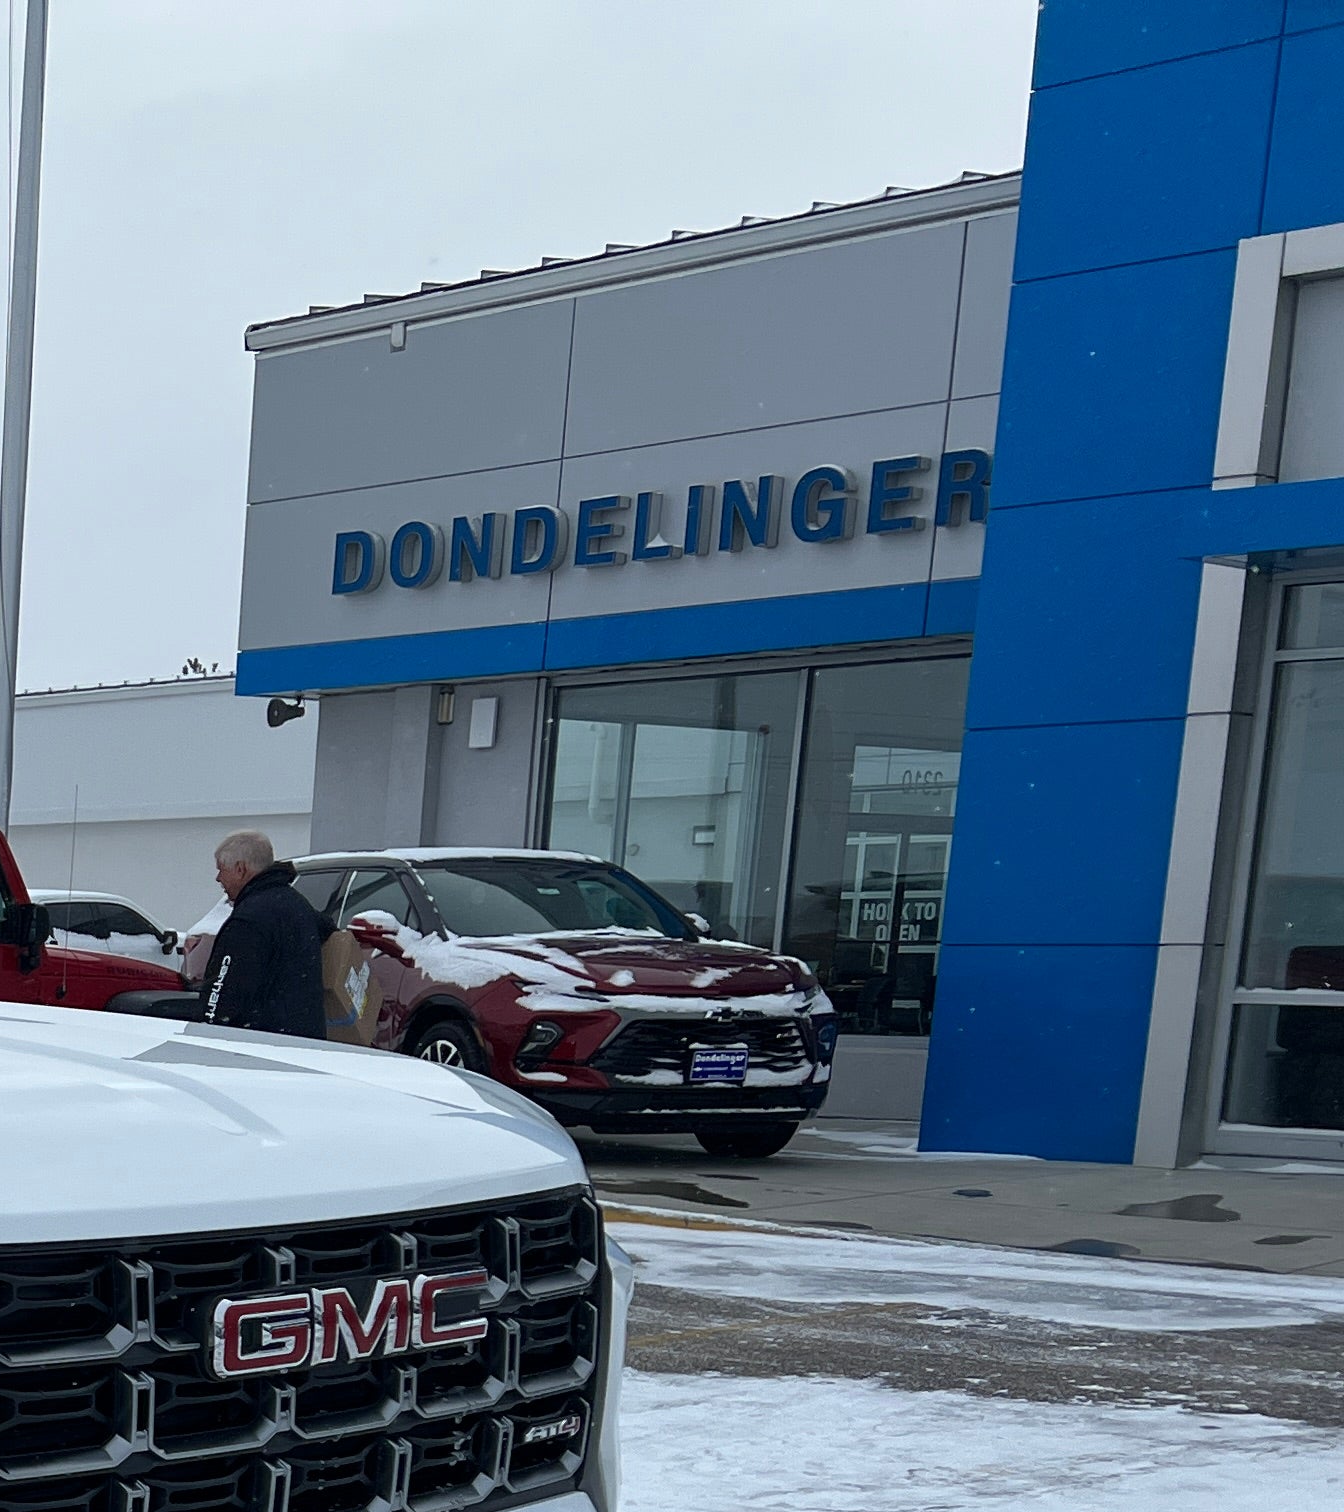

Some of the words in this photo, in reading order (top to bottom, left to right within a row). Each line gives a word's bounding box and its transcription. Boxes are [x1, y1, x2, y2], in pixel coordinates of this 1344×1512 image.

[331, 448, 993, 597] DONDELINGER
[863, 902, 910, 921] HOK
[914, 902, 937, 921] TO
[875, 924, 921, 941] OEN
[695, 1053, 746, 1065] Dondelinger
[213, 1268, 488, 1379] GMC
[523, 1416, 581, 1442] AT4
